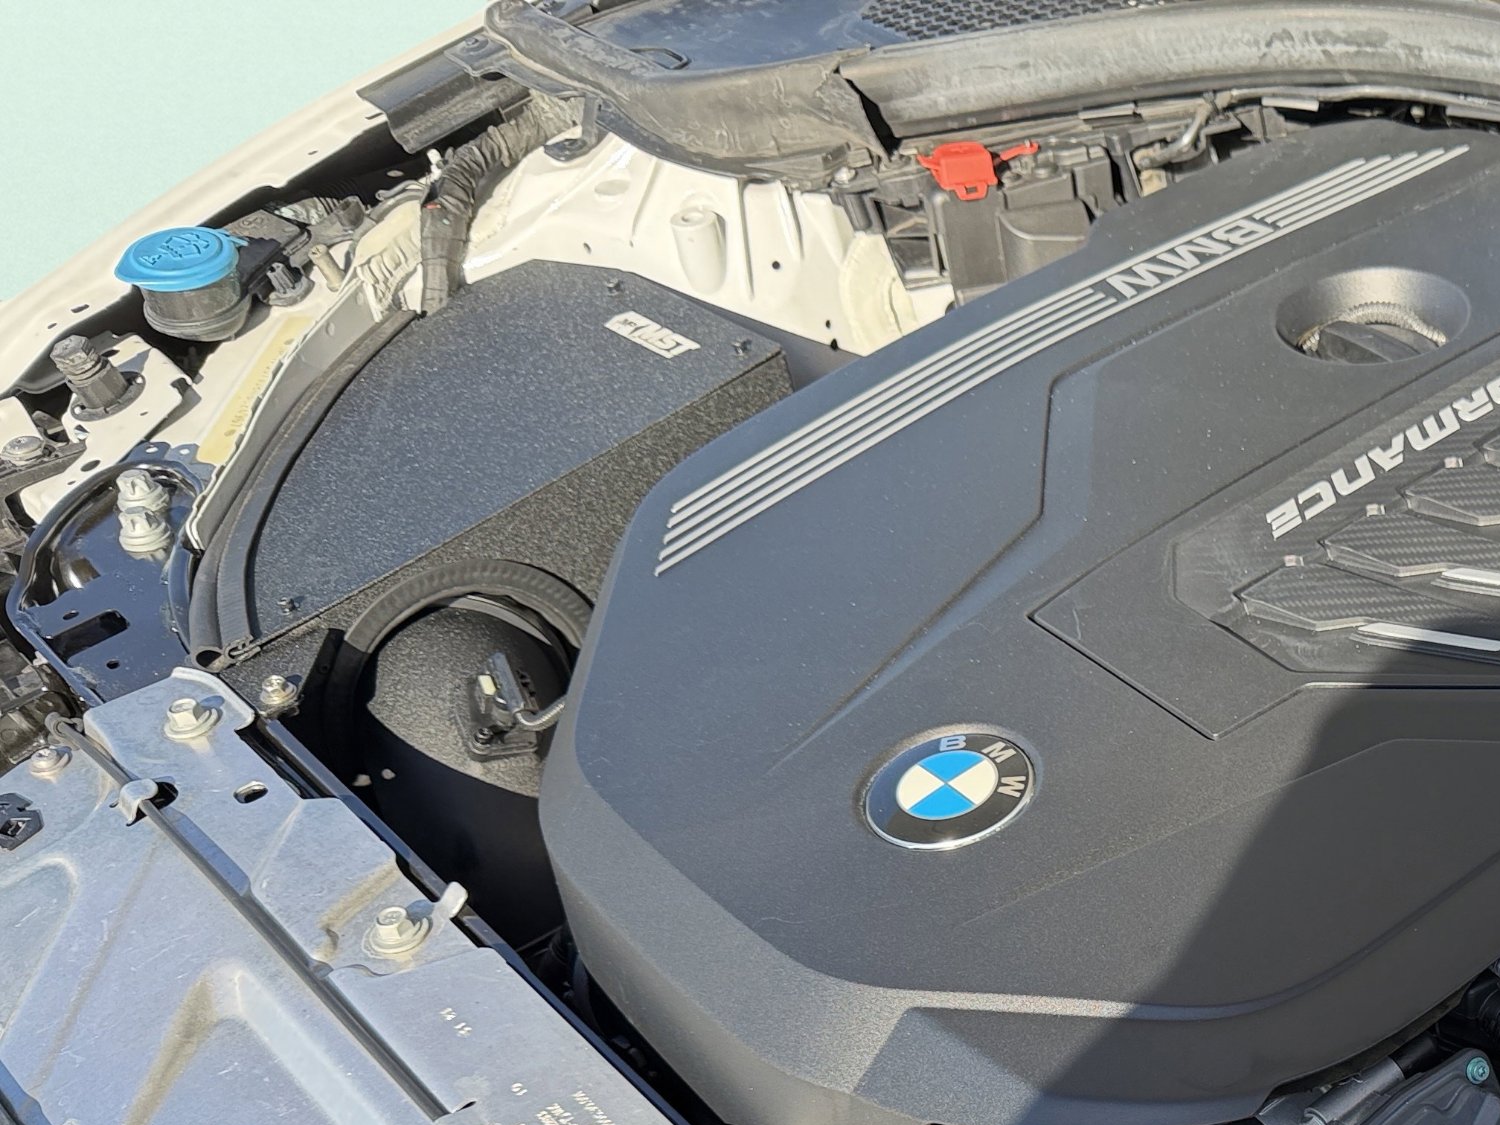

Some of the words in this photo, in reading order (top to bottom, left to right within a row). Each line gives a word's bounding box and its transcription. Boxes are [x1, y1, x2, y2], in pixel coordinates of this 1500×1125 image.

[1105, 218, 1275, 300] BMW
[626, 318, 701, 357] MST
[938, 734, 1027, 799] BMW
